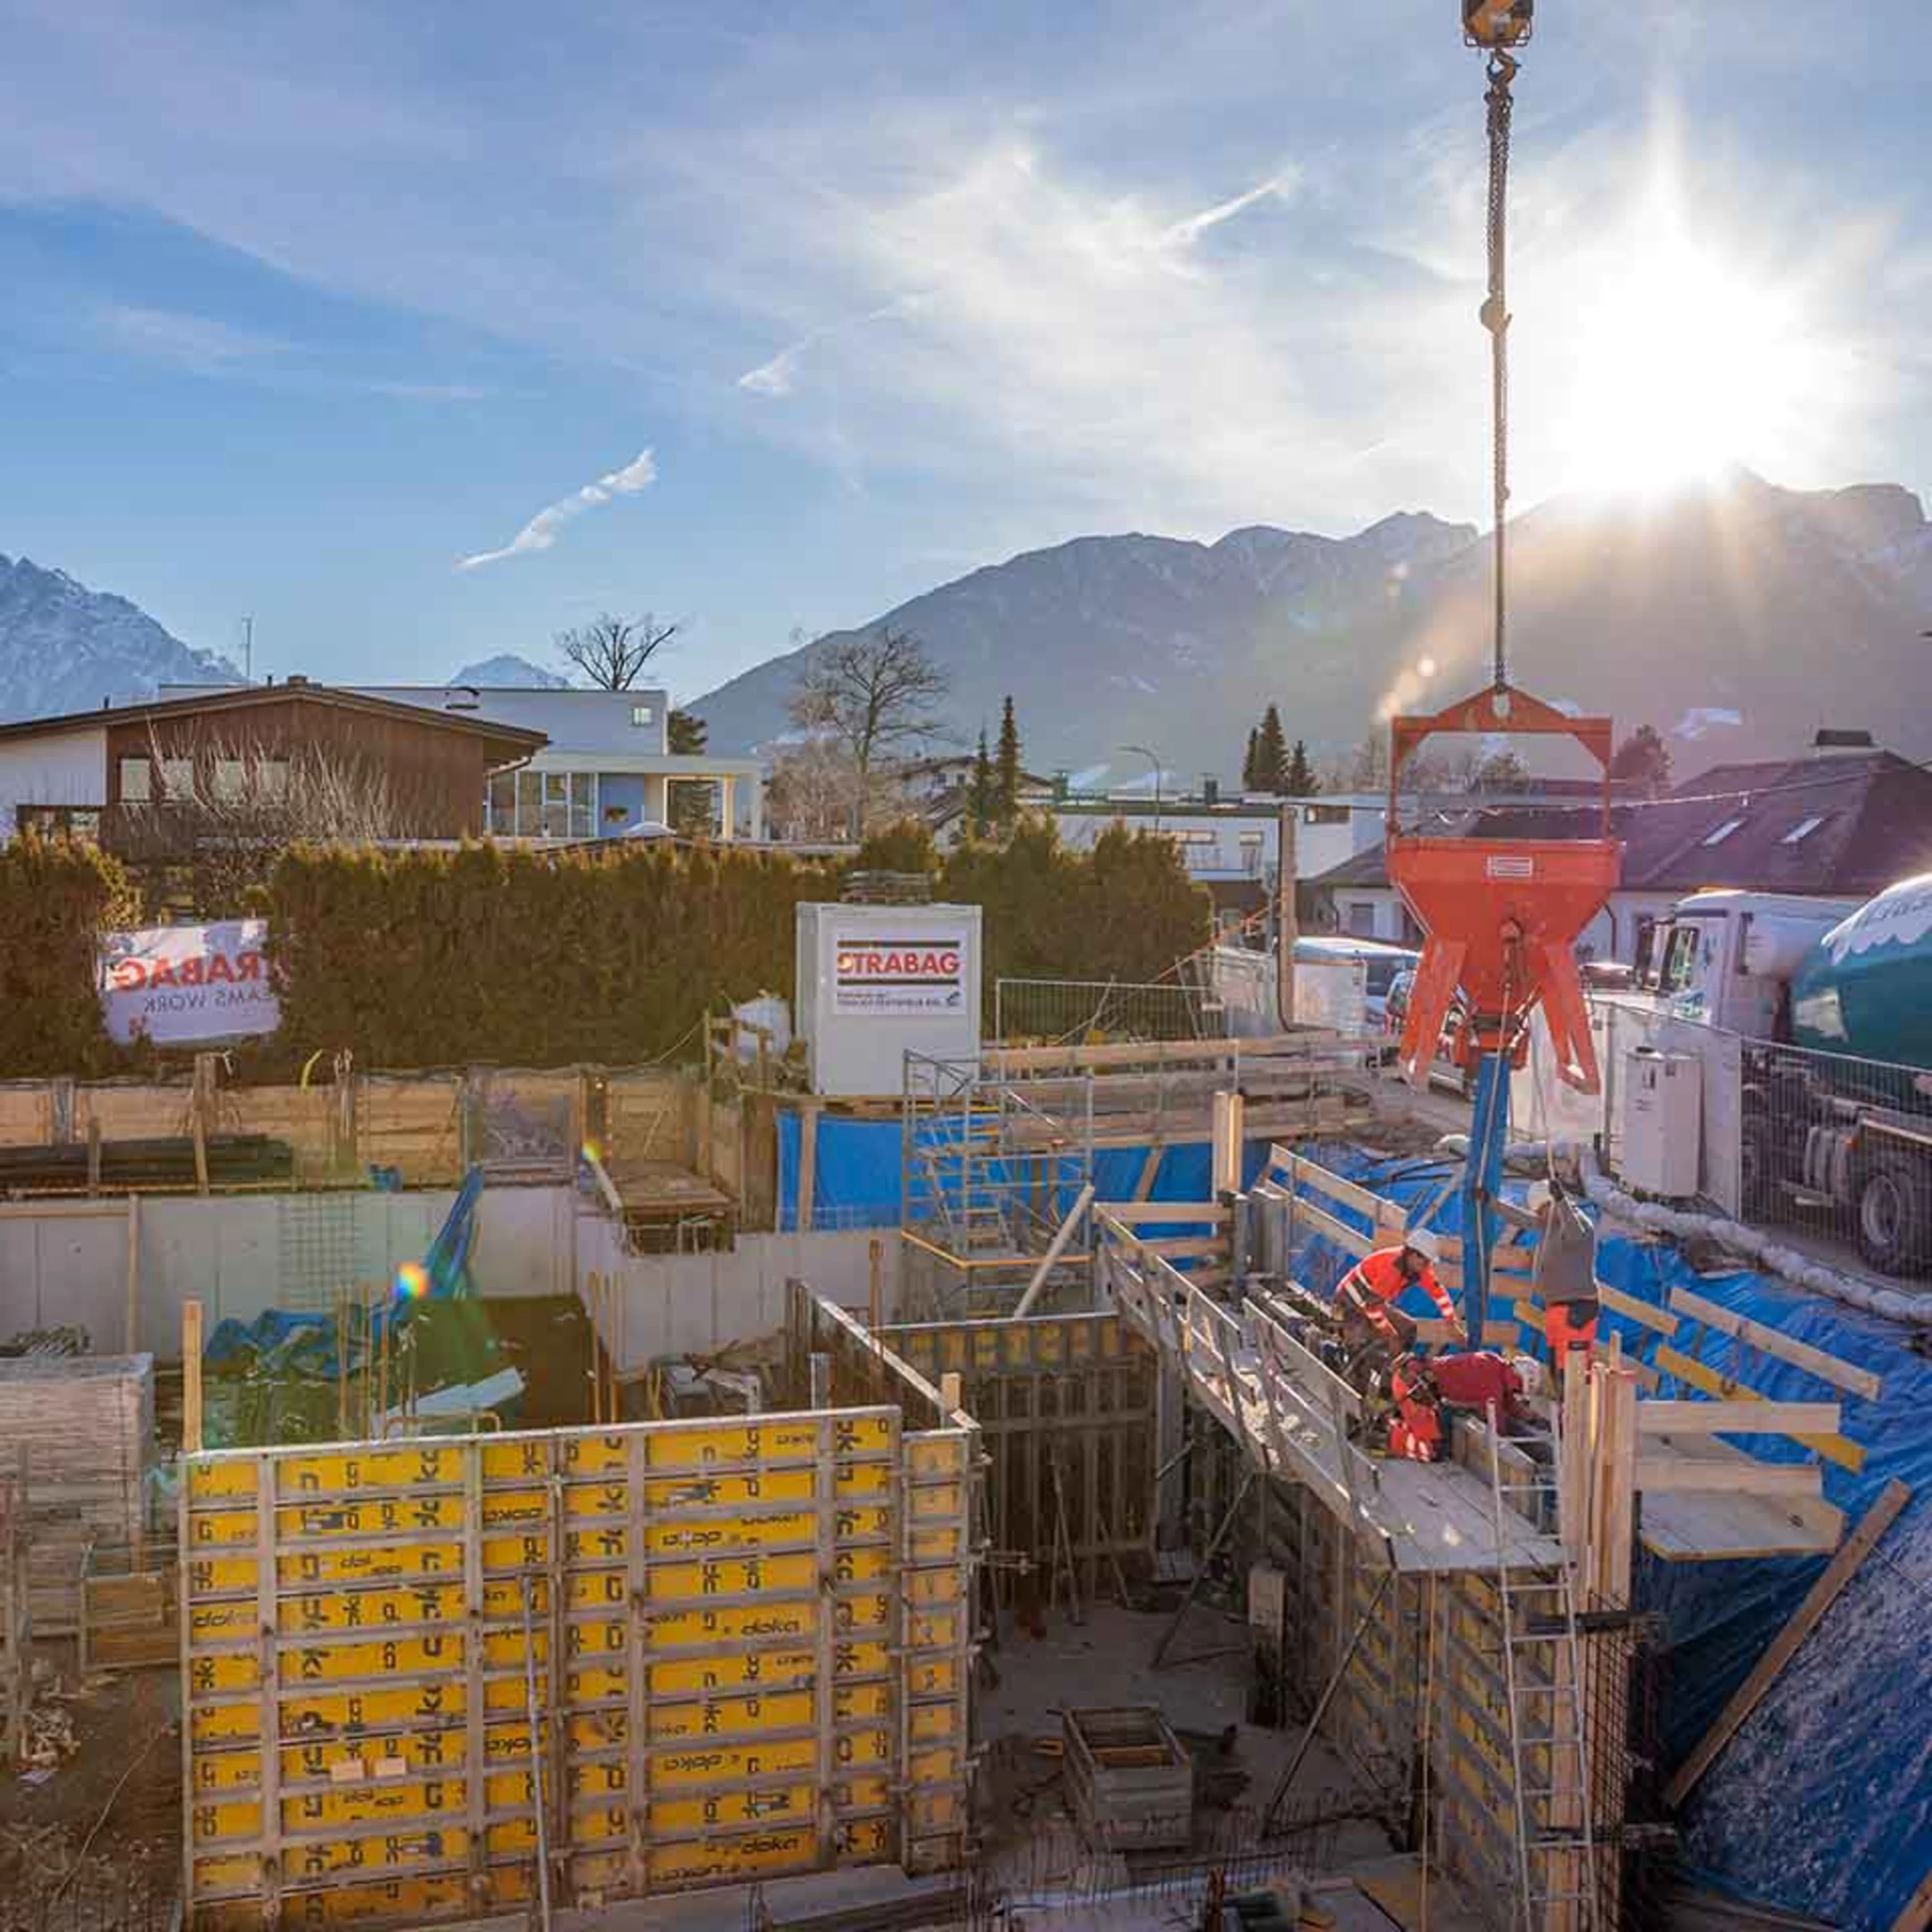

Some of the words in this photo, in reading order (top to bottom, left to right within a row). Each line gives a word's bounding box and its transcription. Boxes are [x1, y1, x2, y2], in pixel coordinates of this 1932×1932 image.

[837, 951, 960, 974] STRABAG
[741, 1617, 799, 1635] doka
[741, 1836, 799, 1854] doka
